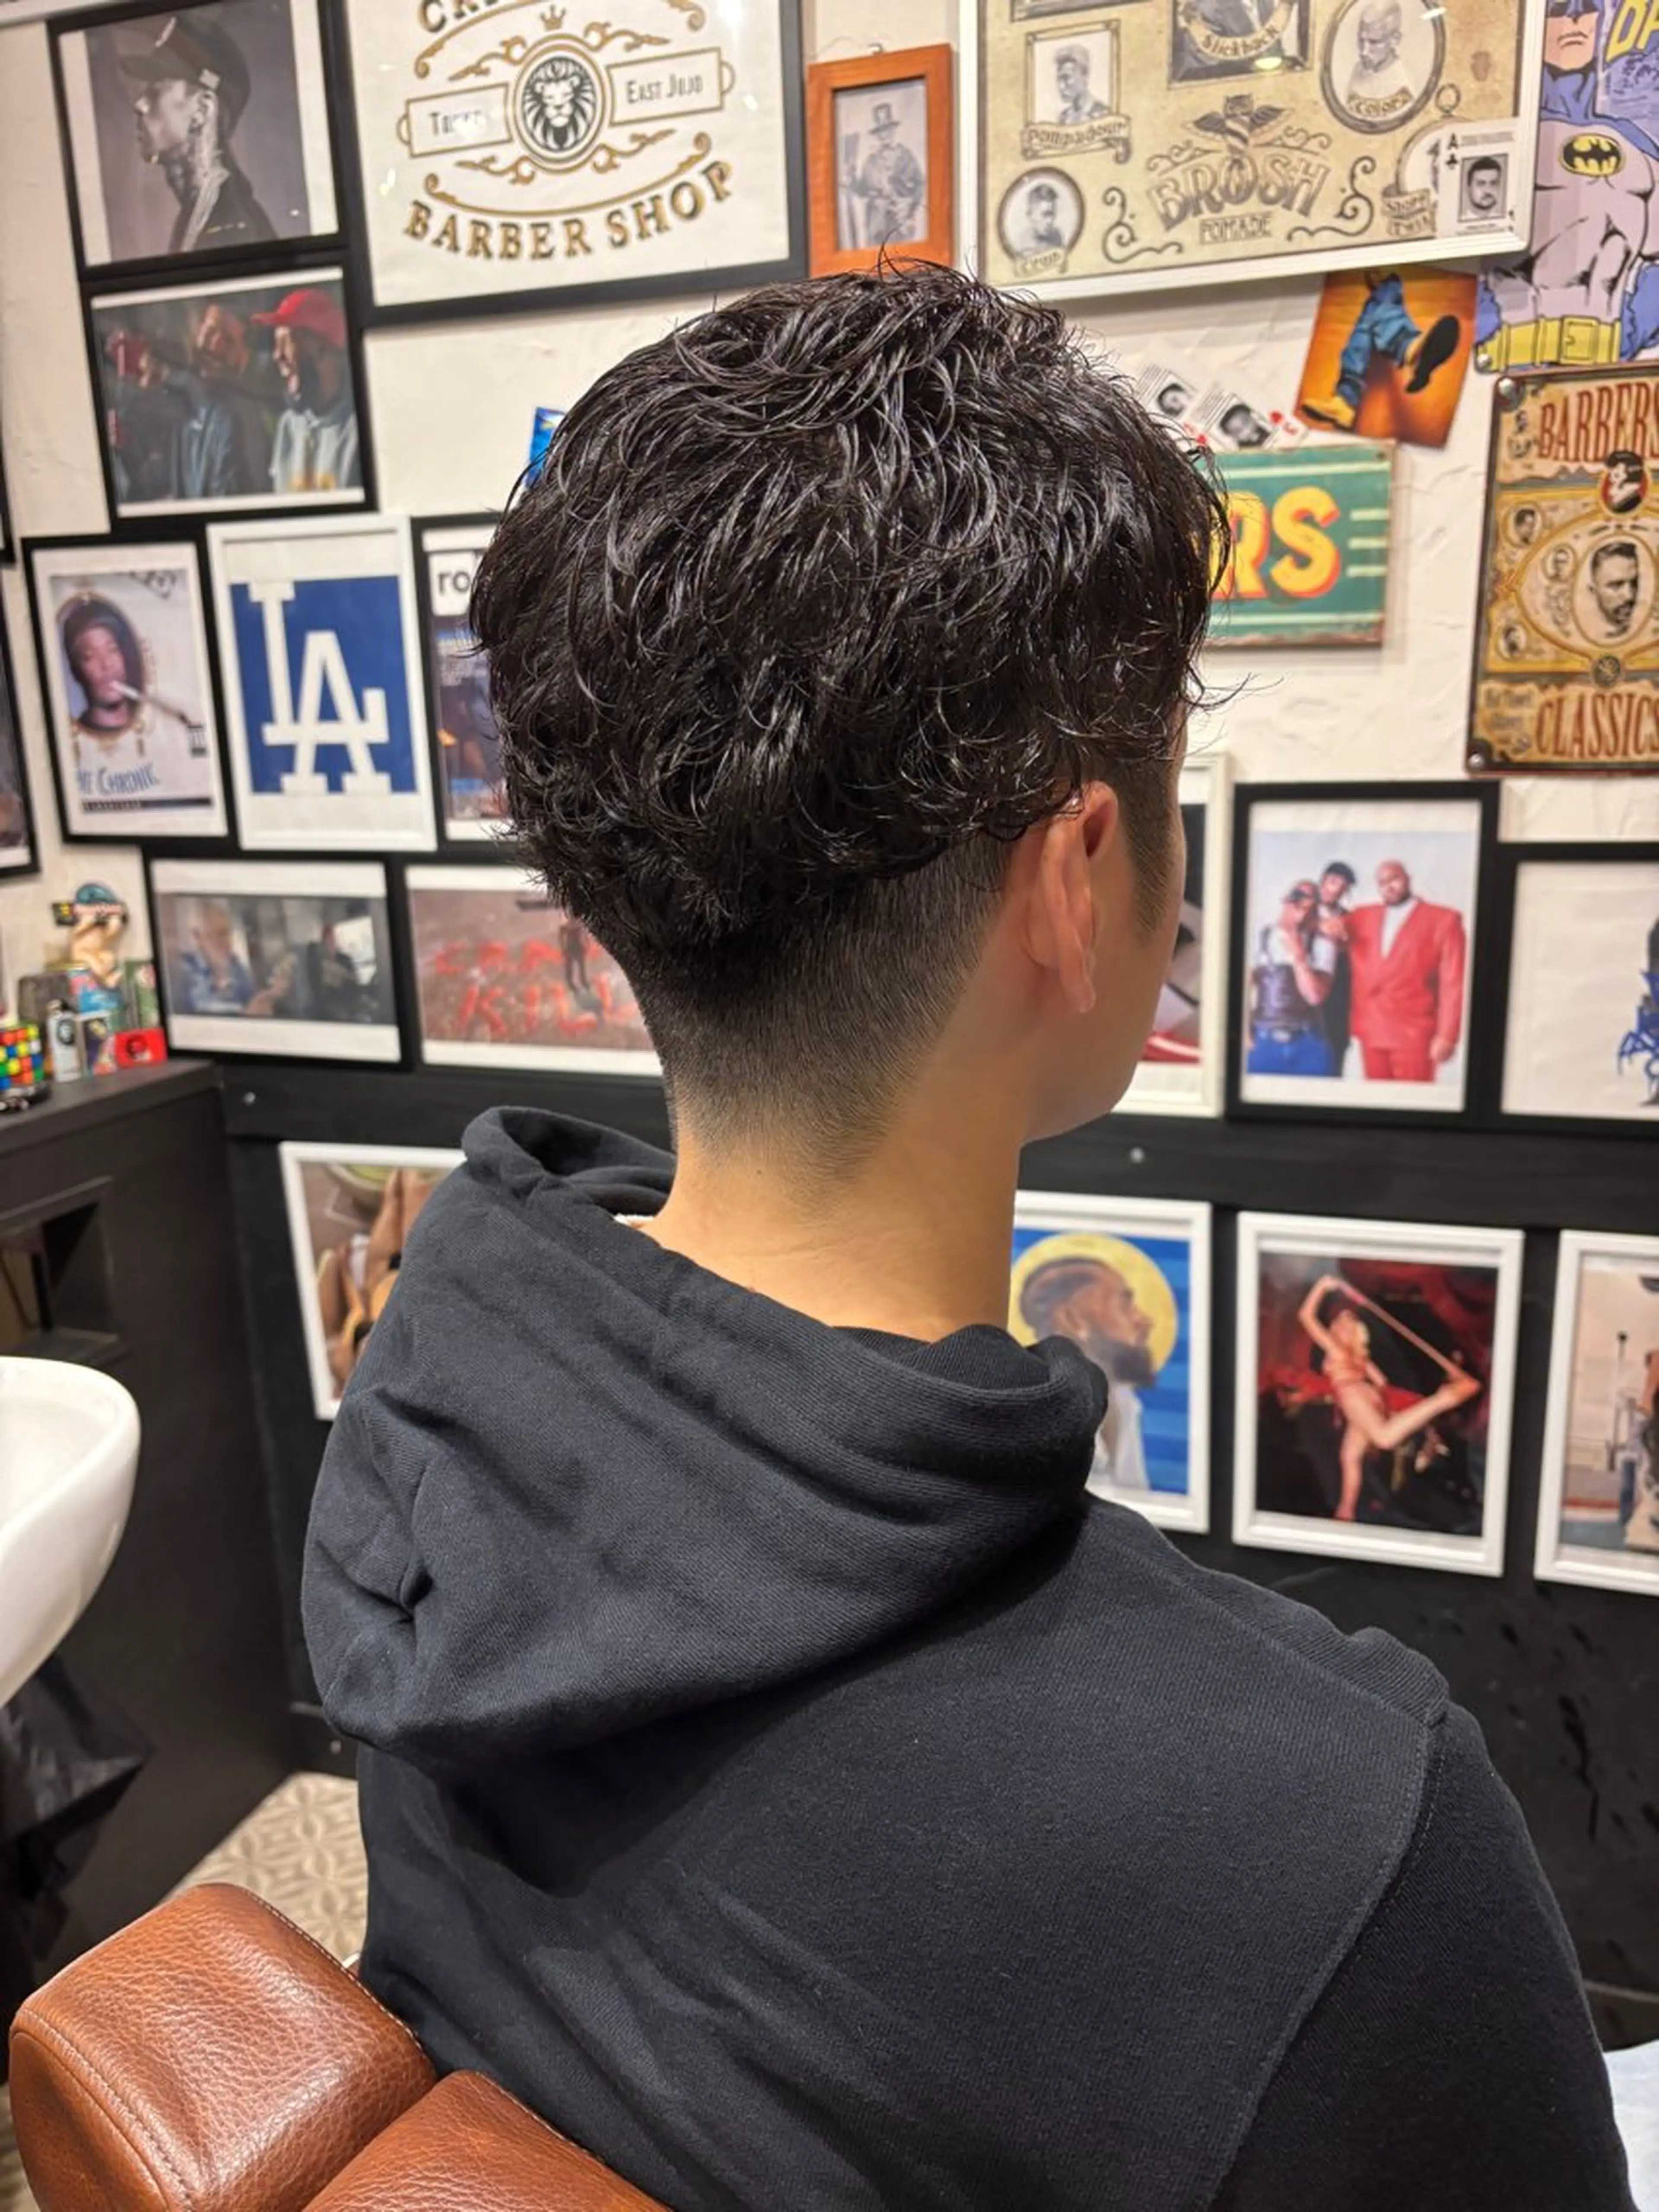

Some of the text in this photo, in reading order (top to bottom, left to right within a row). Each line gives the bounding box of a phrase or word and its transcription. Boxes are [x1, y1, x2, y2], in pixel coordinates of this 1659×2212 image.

[403, 159, 734, 260] BARBER SHOP
[248, 579, 389, 795] LA
